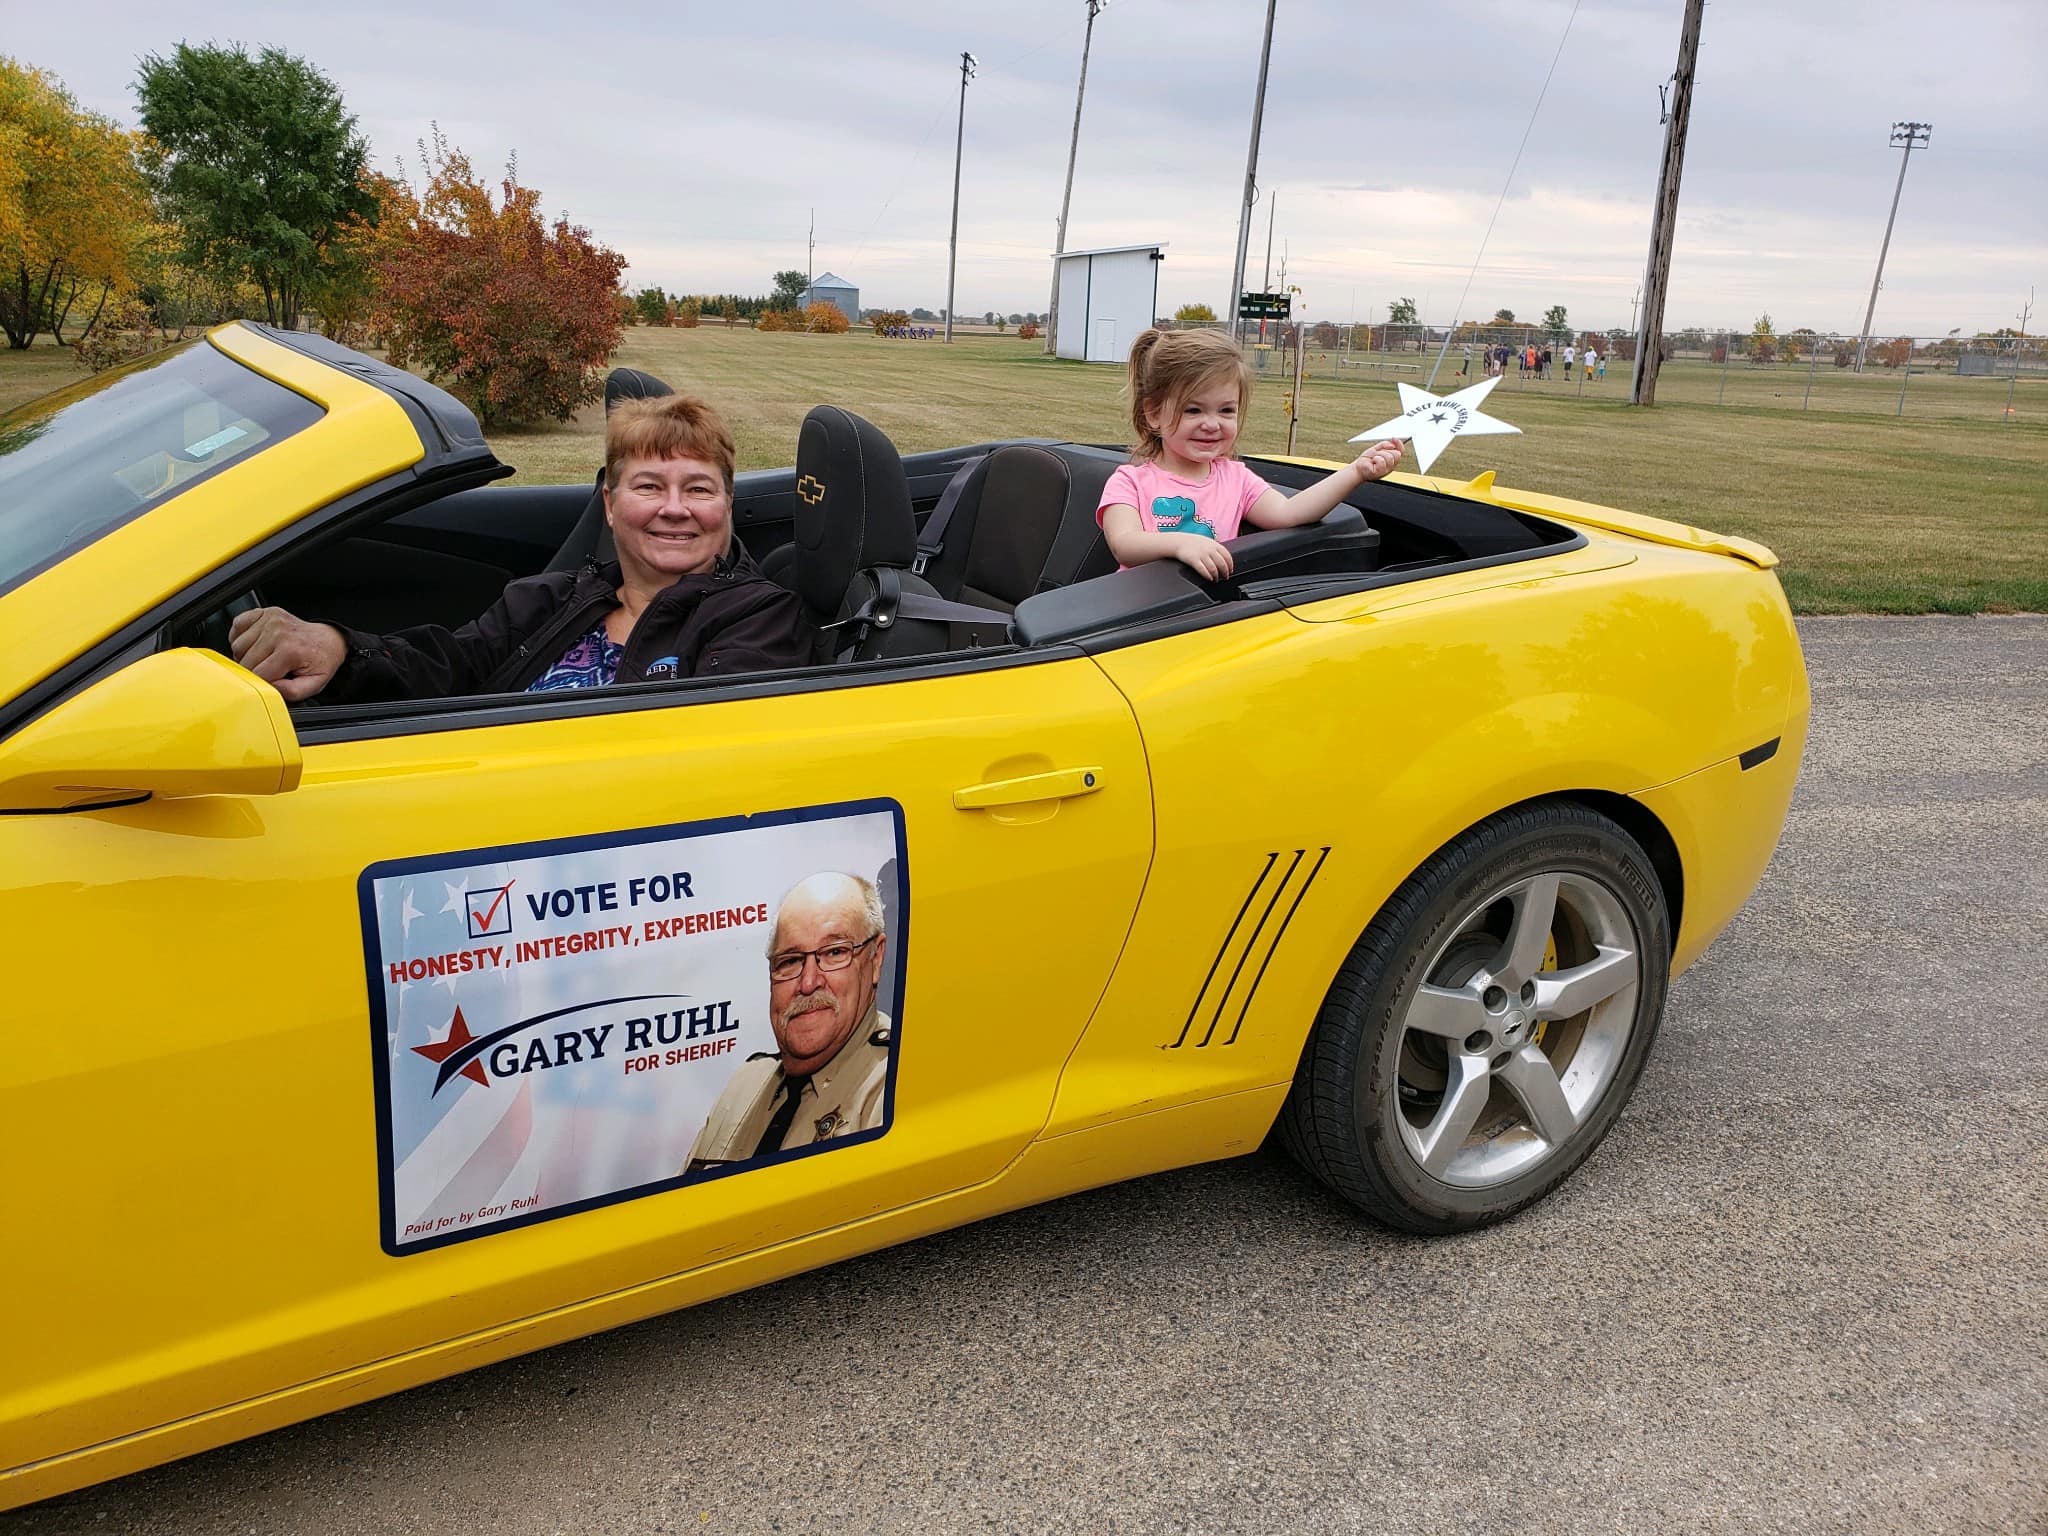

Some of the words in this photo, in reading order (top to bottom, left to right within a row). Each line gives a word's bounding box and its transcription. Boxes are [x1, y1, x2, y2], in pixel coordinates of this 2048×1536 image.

[526, 882, 619, 921] VOTE
[629, 871, 694, 907] FOR
[390, 946, 511, 984] HONESTY,
[516, 925, 640, 964] INTEGRITY,
[644, 903, 768, 942] EXPERIENCE
[489, 1024, 614, 1079] GARY
[624, 1000, 740, 1053] RUHL
[624, 1047, 660, 1075] FOR
[664, 1037, 737, 1066] SHERIFF
[405, 1221, 433, 1236] Paid
[435, 1216, 456, 1231] for
[459, 1212, 474, 1224] by
[478, 1204, 508, 1218] Gary
[511, 1194, 539, 1211] Ruhl
